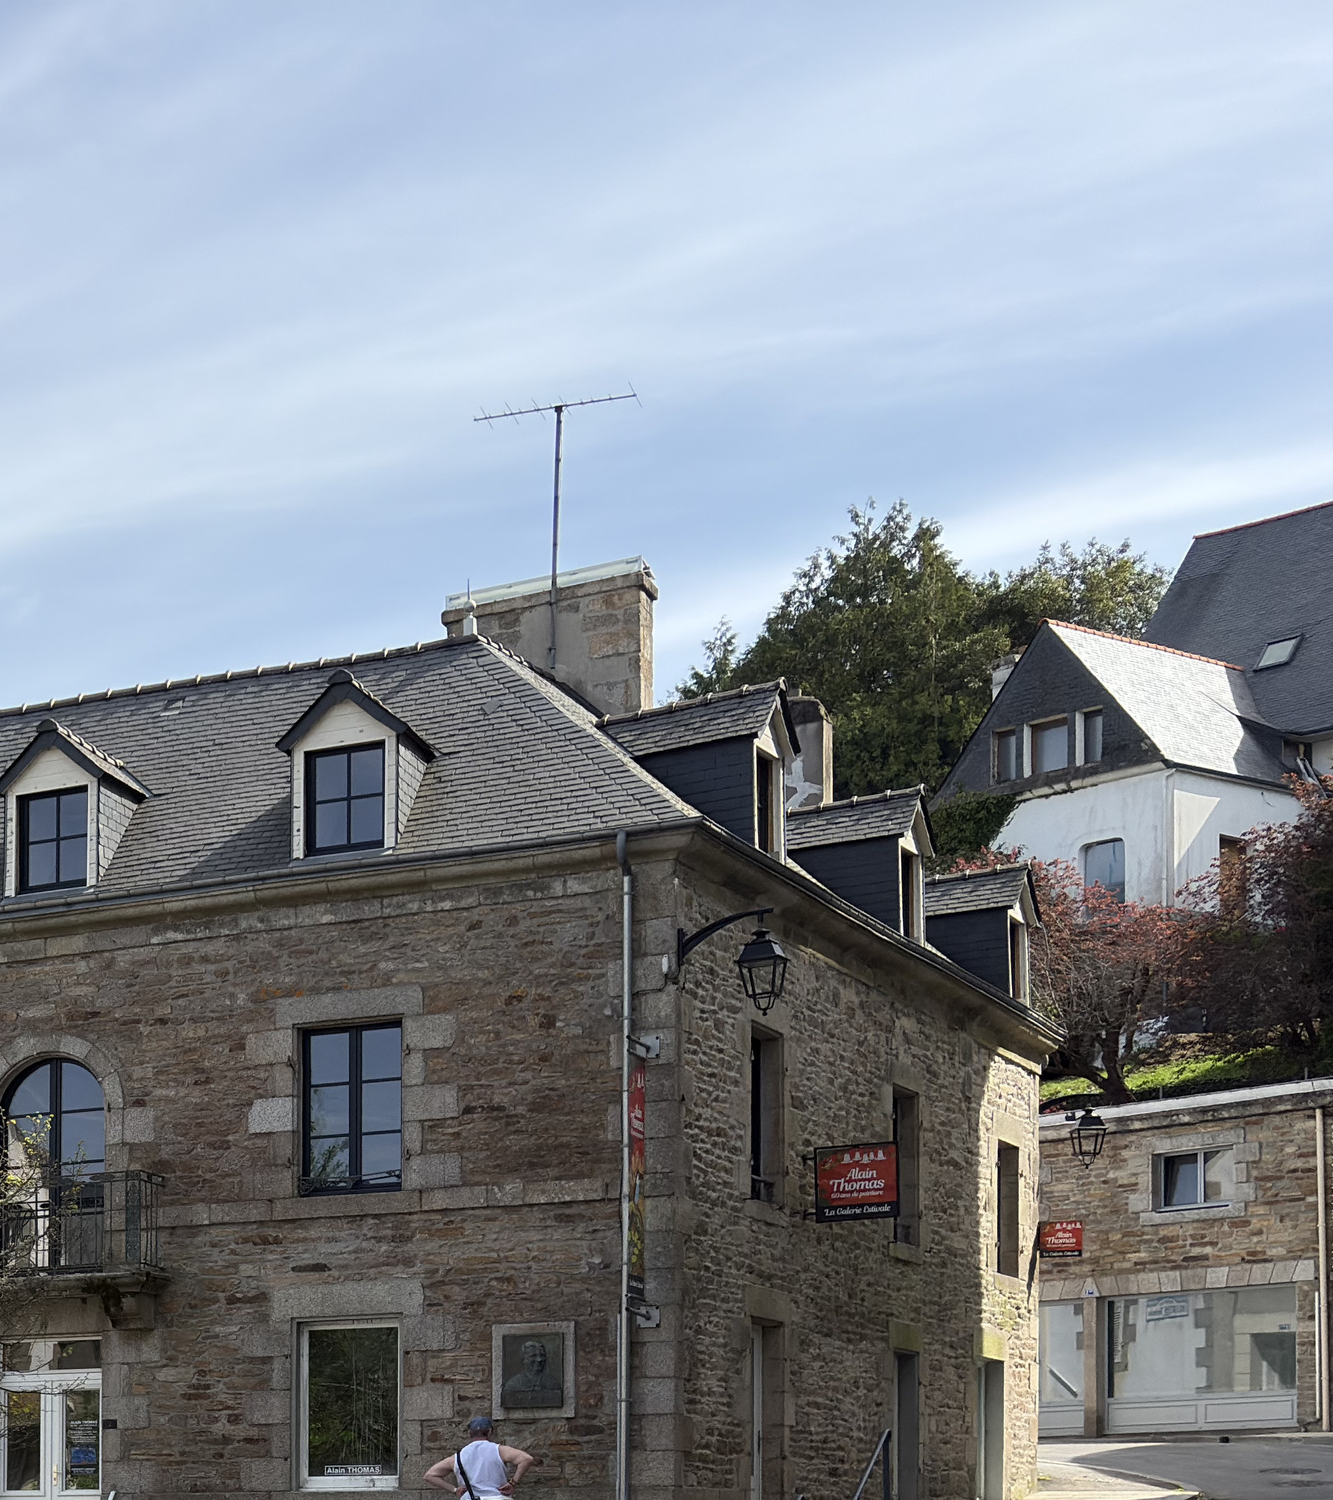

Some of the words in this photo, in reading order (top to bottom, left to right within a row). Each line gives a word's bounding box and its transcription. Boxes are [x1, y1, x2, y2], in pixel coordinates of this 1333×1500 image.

[846, 1167, 877, 1180] Alain
[829, 1178, 885, 1192] Thomas
[824, 1208, 835, 1217] La
[836, 1206, 862, 1216] Galerie
[863, 1203, 891, 1213] Estivale
[347, 1466, 381, 1474] THOMAS
